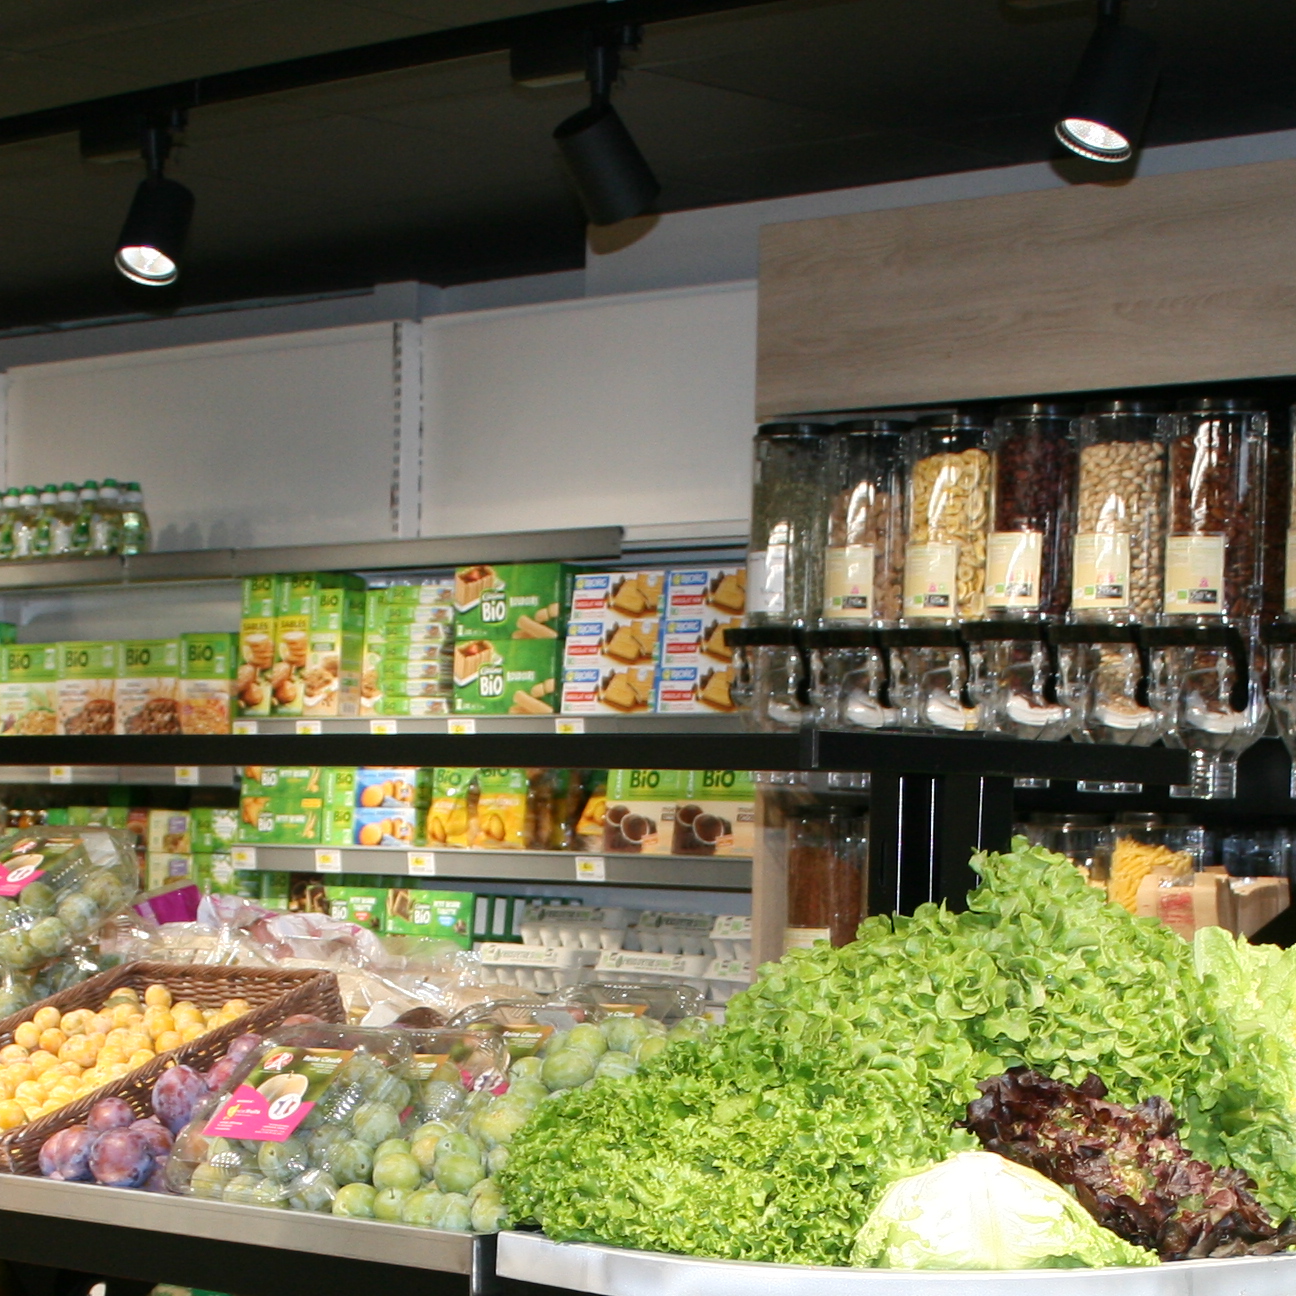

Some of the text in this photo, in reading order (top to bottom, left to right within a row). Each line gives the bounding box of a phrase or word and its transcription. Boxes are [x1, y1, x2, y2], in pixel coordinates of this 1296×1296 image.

[482, 600, 505, 622] BiO
[126, 649, 151, 667] BiO
[188, 643, 214, 663] BiO
[480, 675, 504, 696] BiO
[630, 770, 660, 788] BiO
[703, 769, 735, 788] BiO
